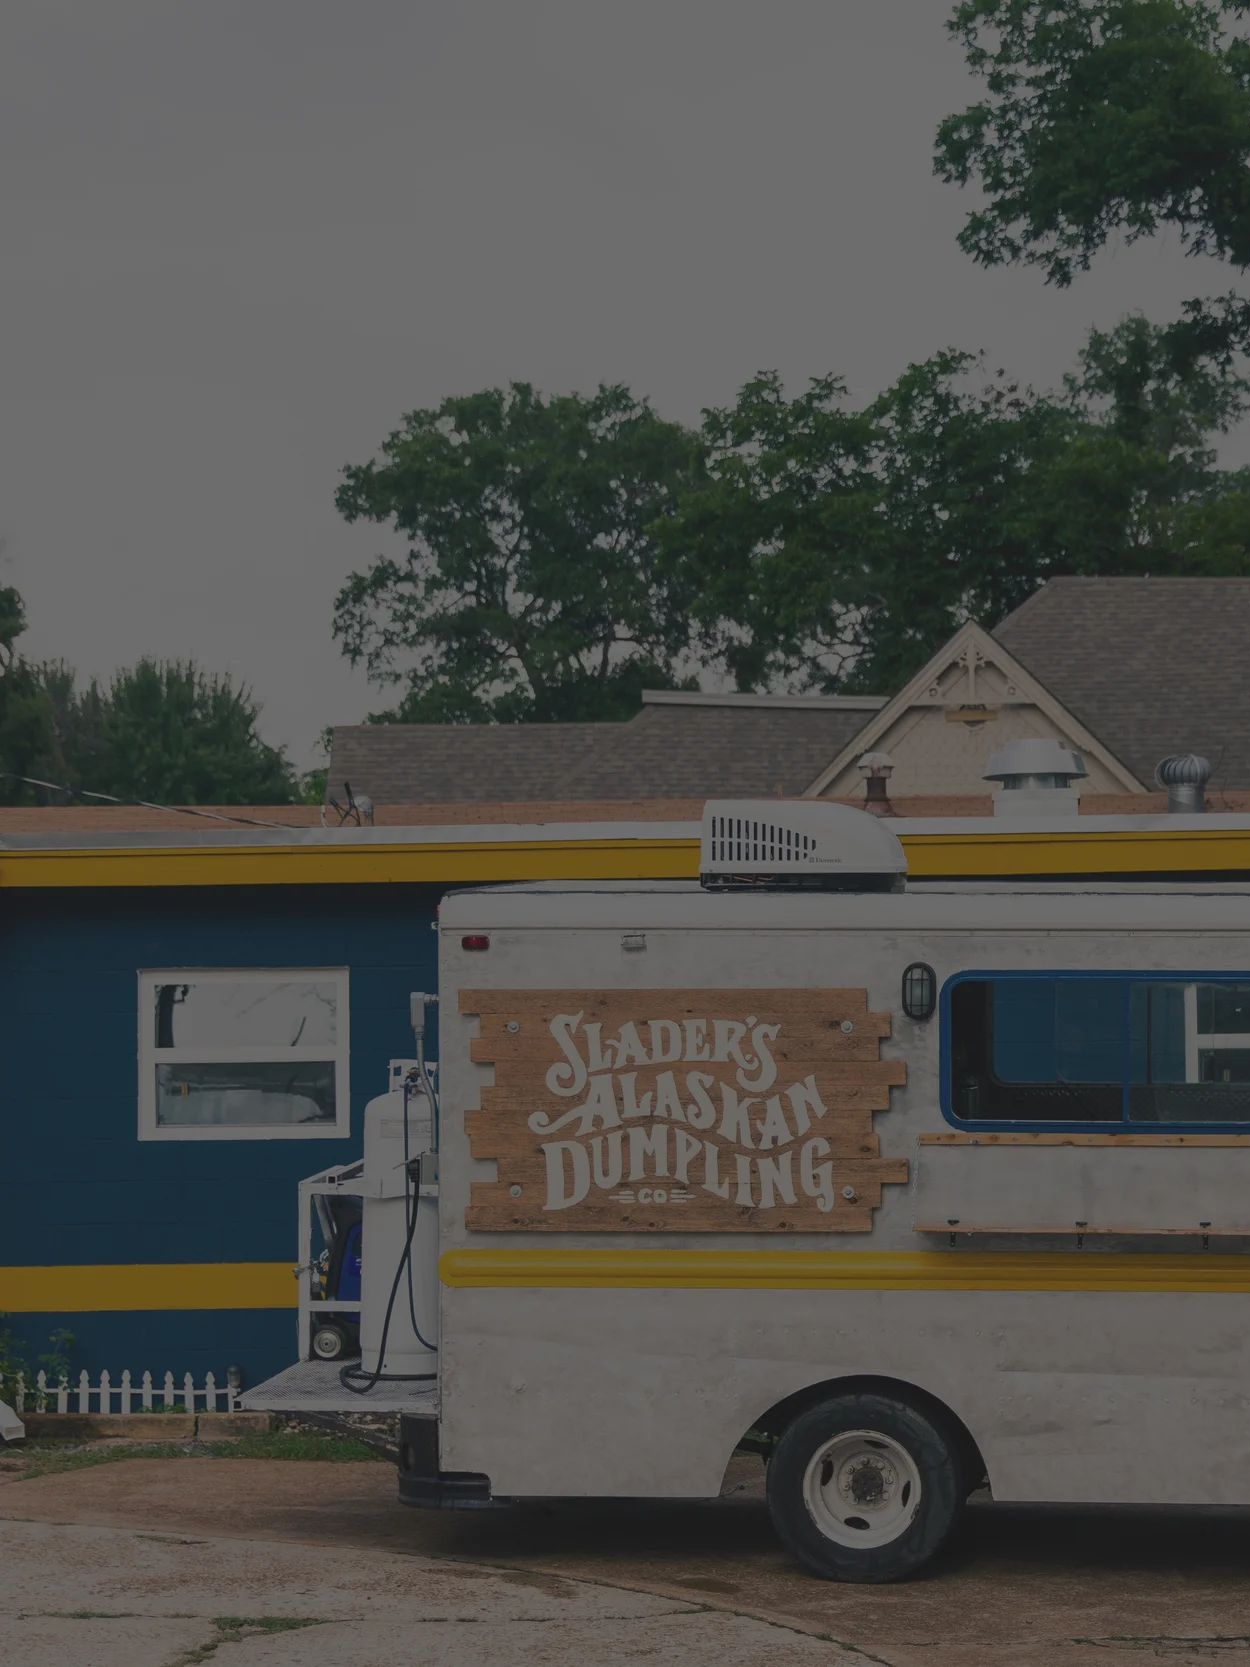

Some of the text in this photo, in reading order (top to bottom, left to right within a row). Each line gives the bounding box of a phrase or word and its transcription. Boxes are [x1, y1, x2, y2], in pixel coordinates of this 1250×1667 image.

[545, 1011, 782, 1097] SLADER'S
[528, 1070, 828, 1150] ALASKAN
[541, 1125, 834, 1212] DUMPLING
[639, 1188, 667, 1204] CO
